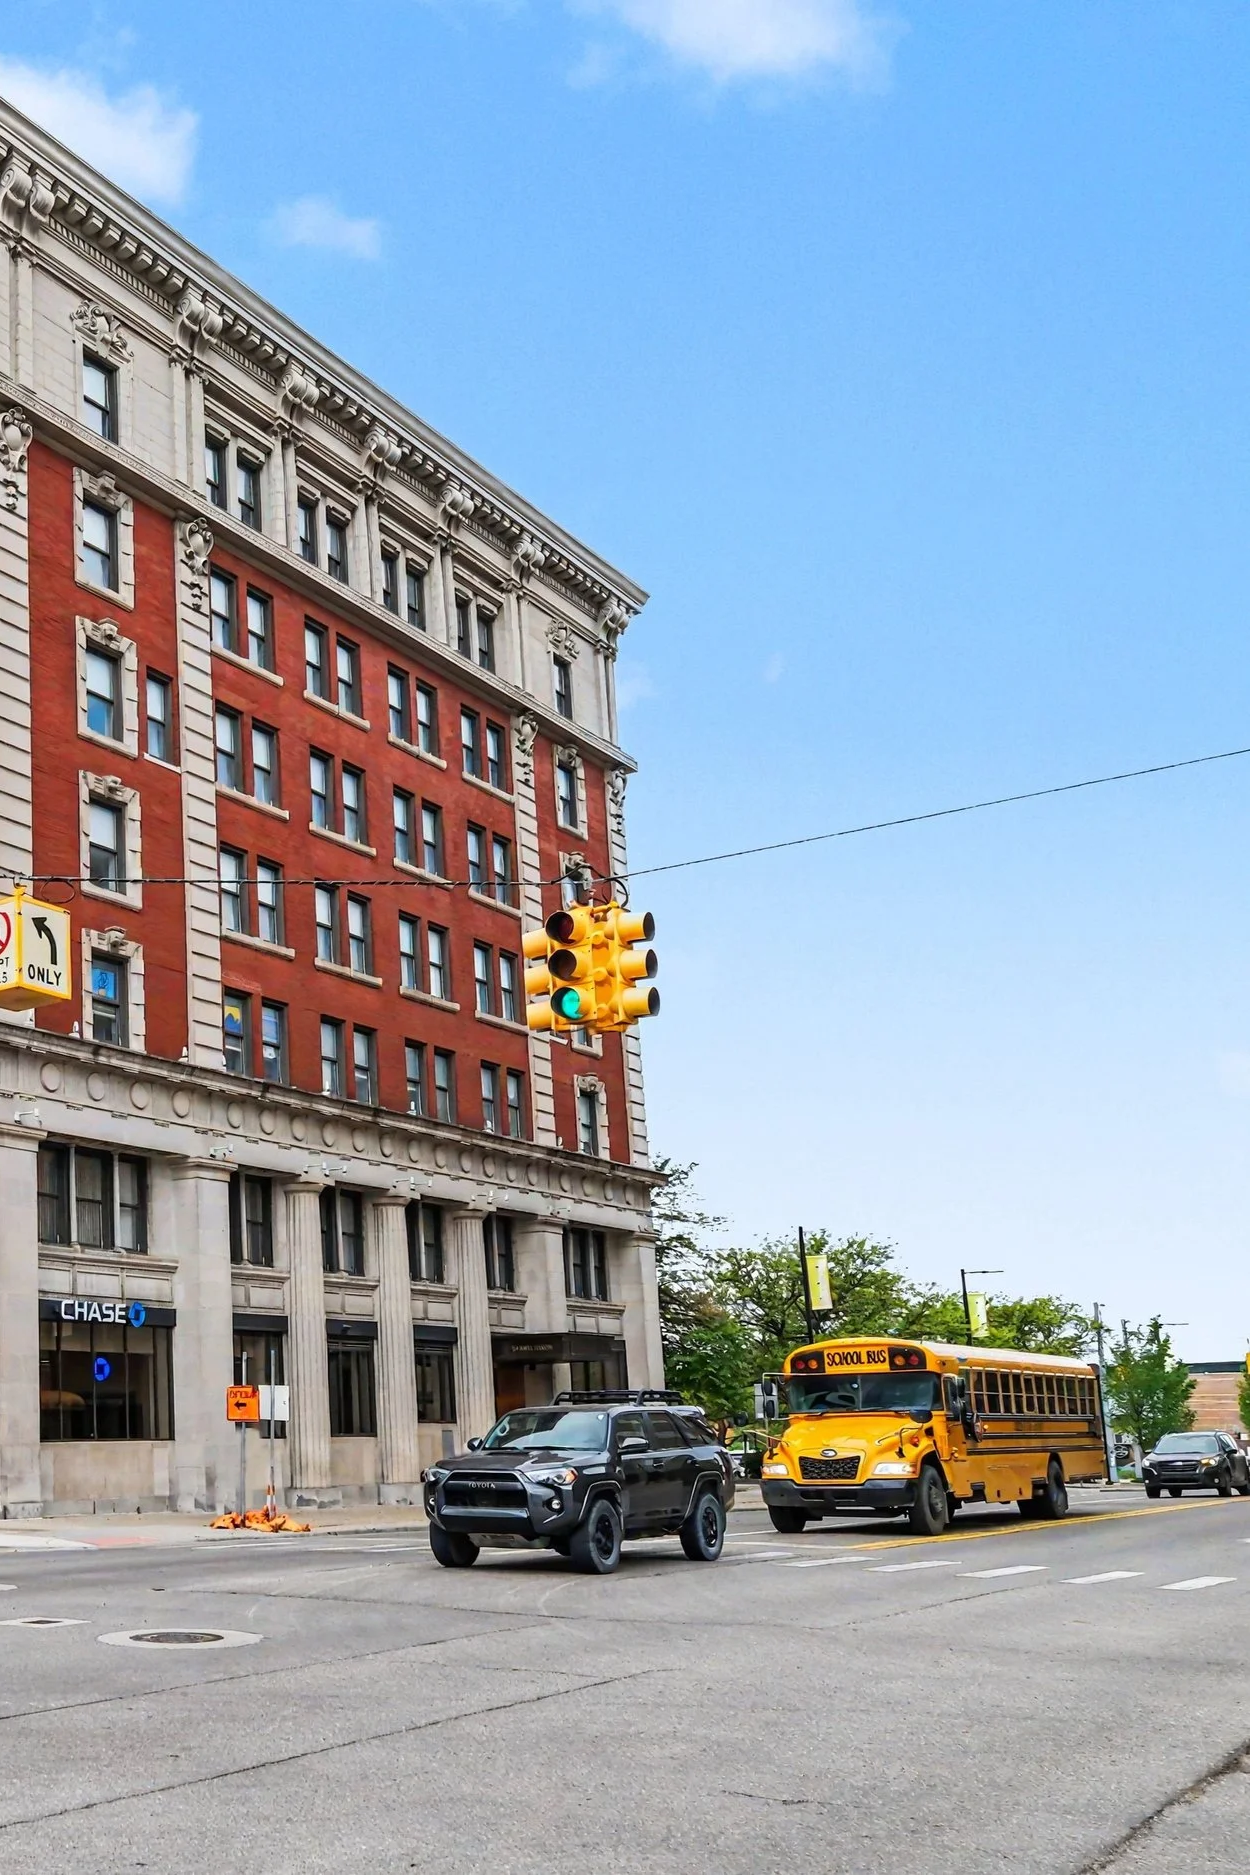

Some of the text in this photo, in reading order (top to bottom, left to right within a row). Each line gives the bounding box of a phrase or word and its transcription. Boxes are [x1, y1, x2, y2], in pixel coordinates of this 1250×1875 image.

[27, 964, 62, 986] ONLY
[61, 1299, 127, 1324] CHASE
[826, 1349, 887, 1367] SCHOOL BUS
[468, 1481, 496, 1489] TOYOTA
